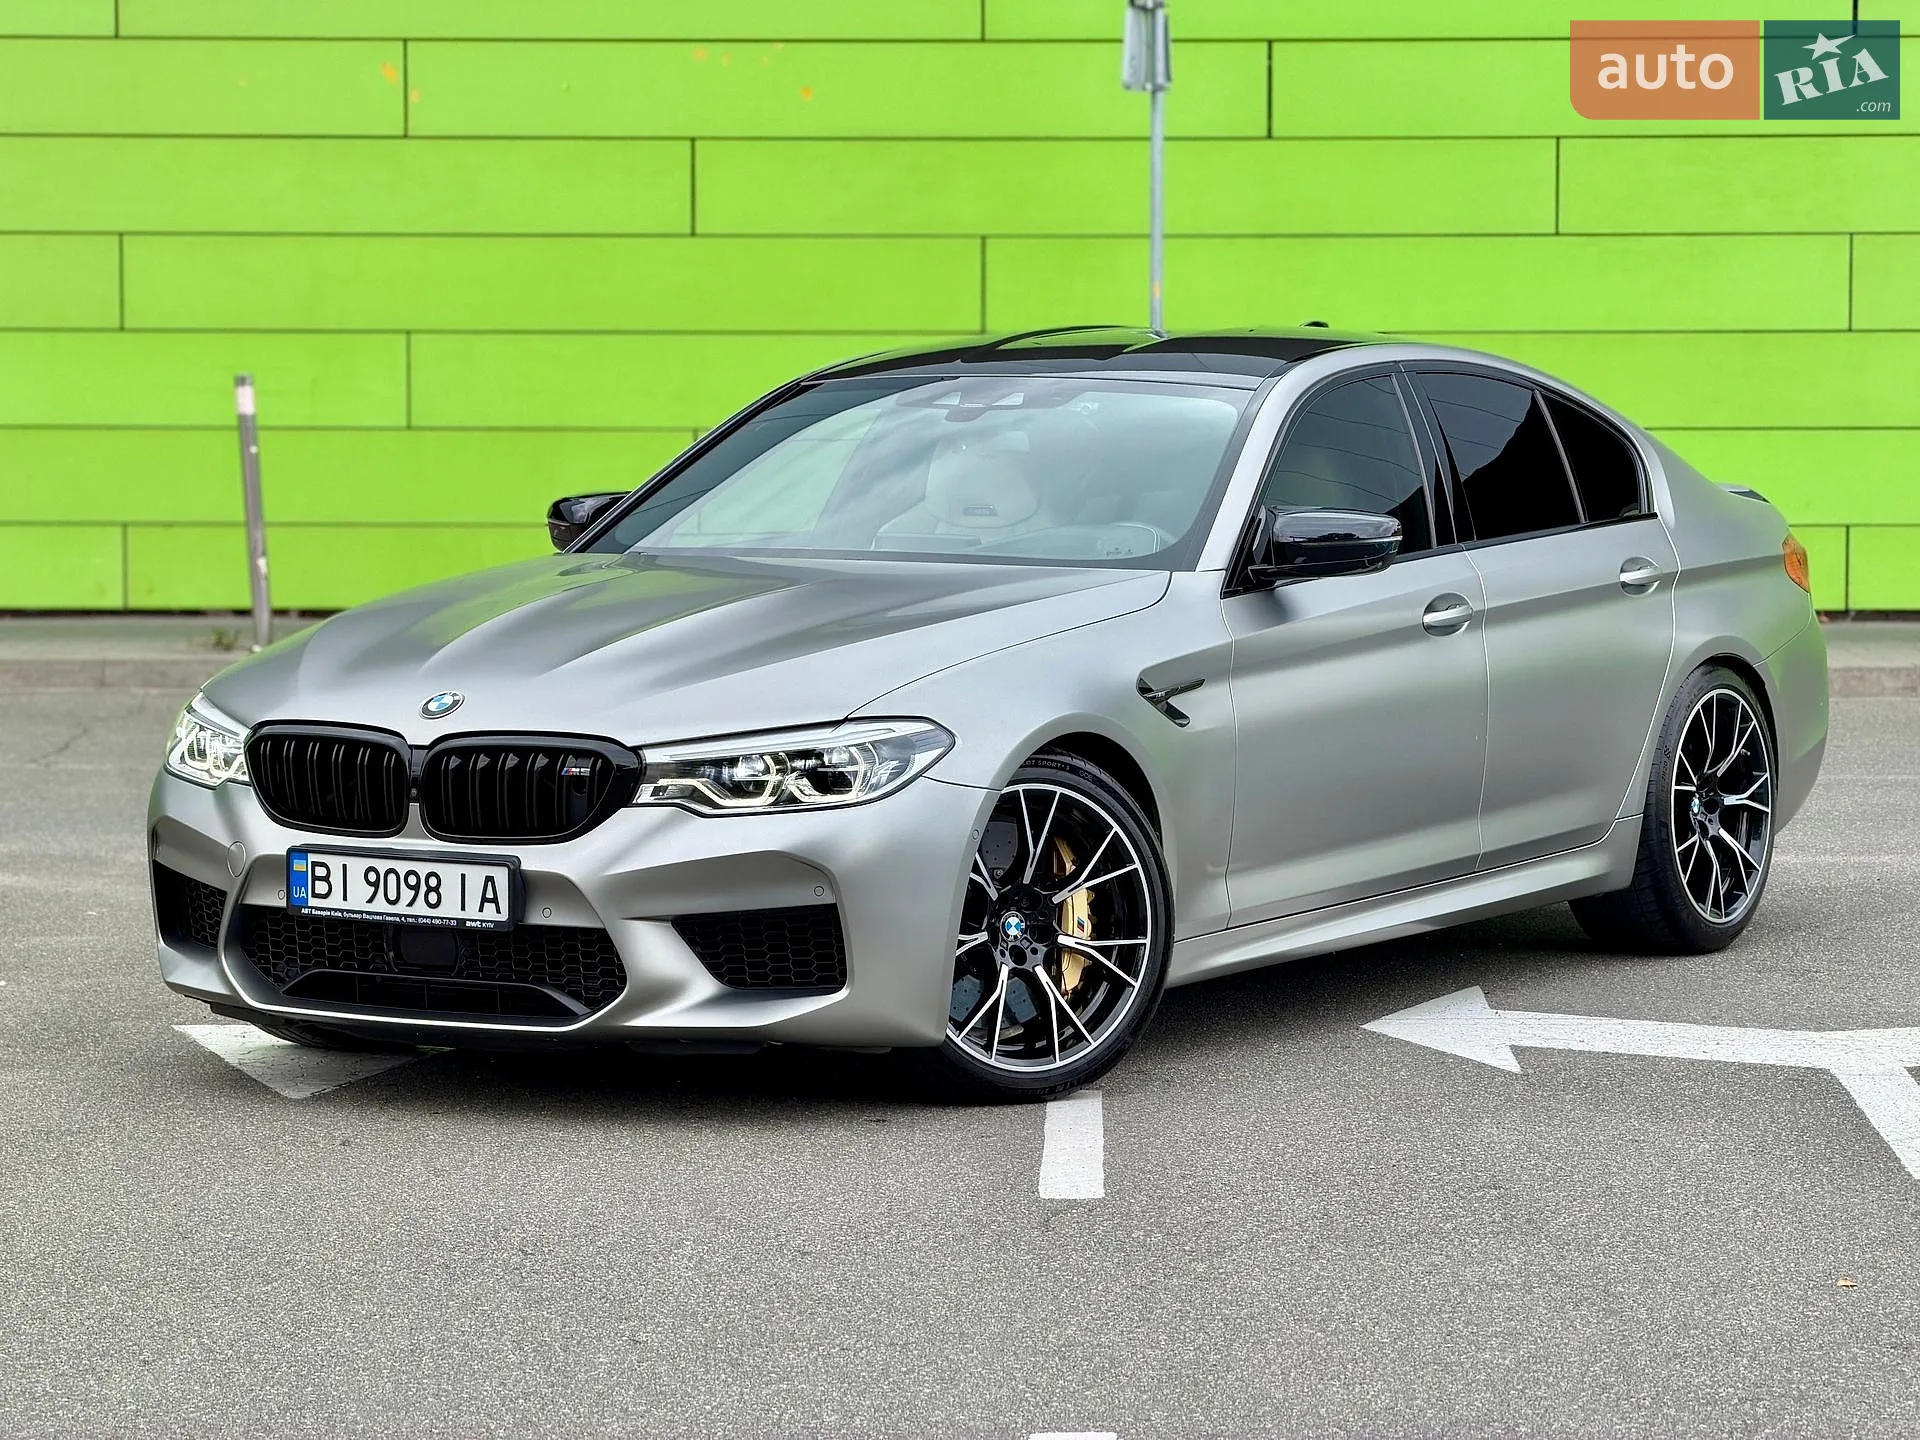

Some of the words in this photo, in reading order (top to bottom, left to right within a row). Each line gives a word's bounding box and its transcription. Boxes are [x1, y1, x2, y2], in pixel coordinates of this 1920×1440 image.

[293, 886, 307, 899] UA
[310, 860, 348, 902] BI
[363, 865, 442, 910] 9098
